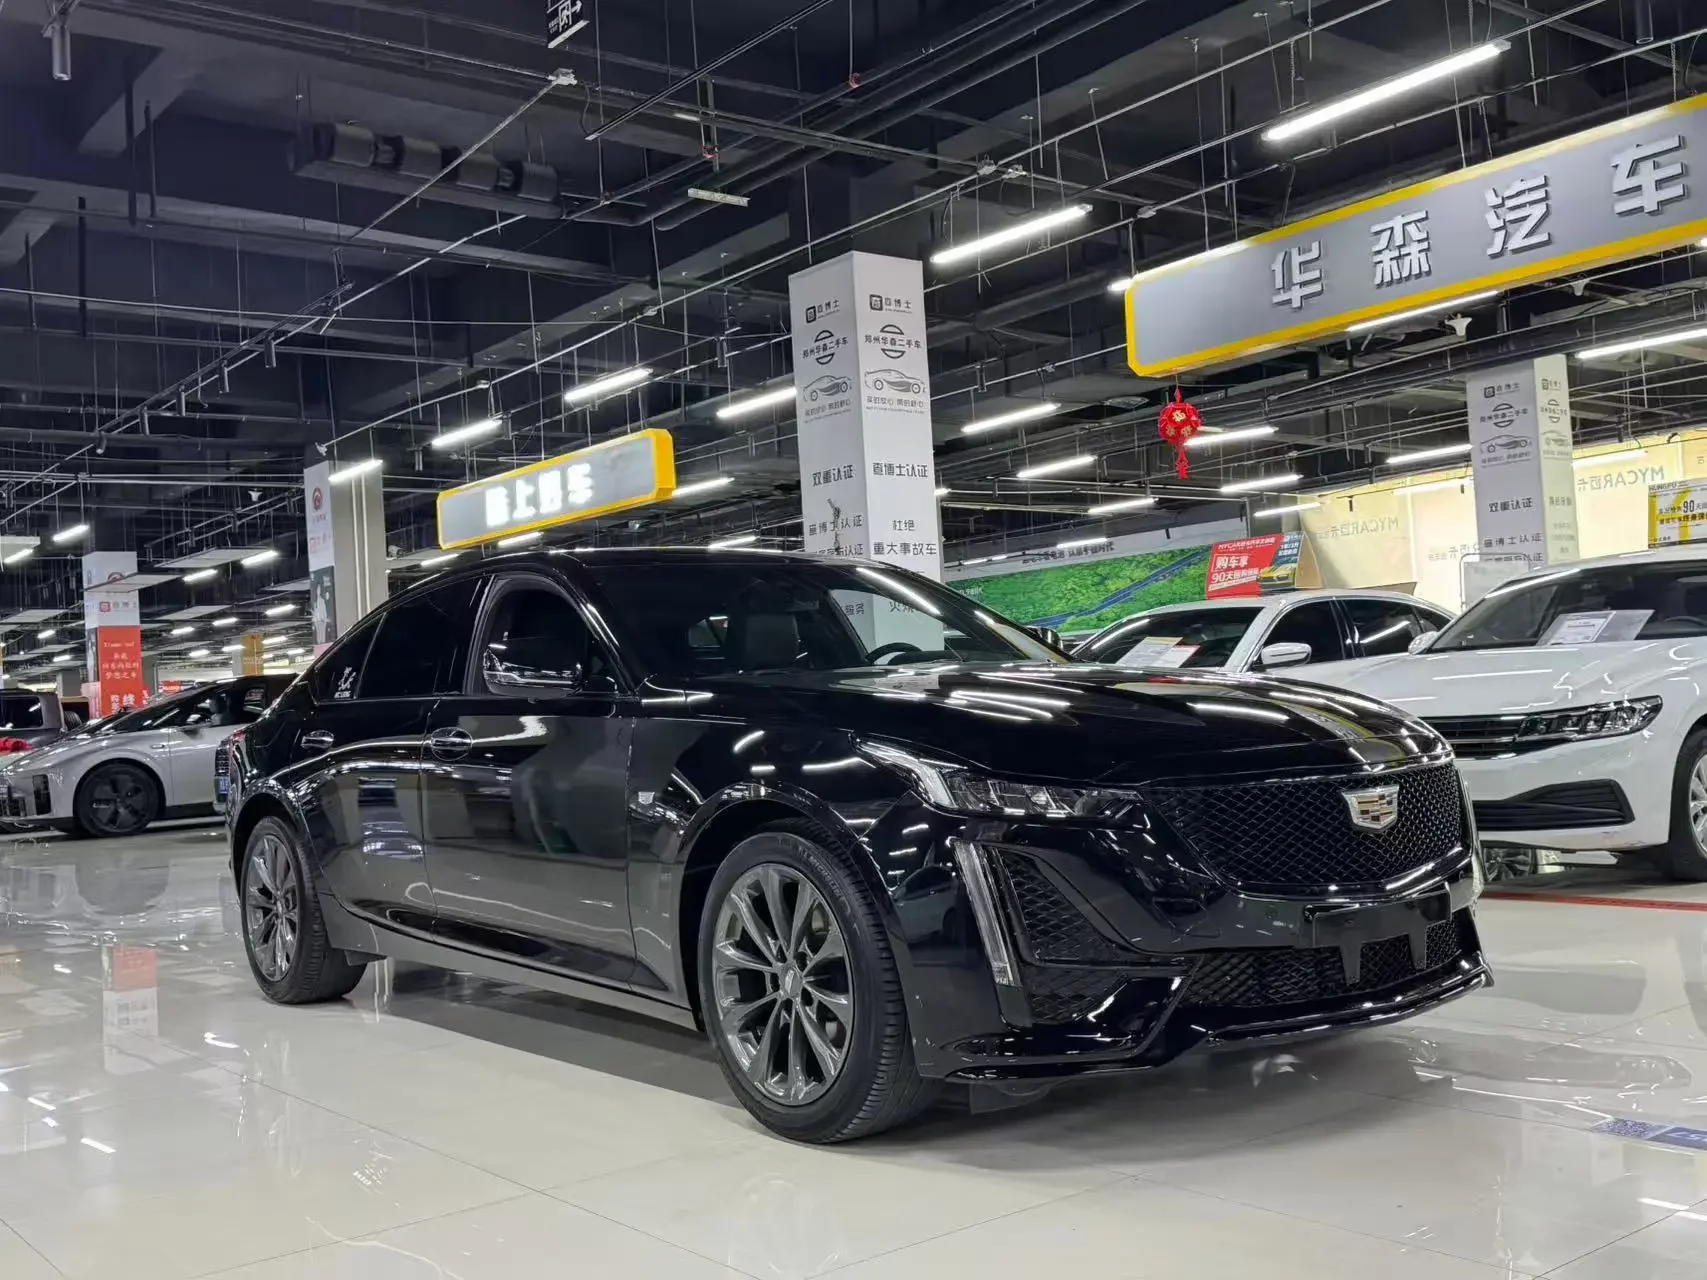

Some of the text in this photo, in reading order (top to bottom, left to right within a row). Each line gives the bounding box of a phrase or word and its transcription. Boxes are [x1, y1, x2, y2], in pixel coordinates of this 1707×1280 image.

[1271, 134, 1688, 309] 华森汽车
[802, 337, 849, 359] 郑州华森二手车
[864, 334, 922, 349] 郑州华森二手车
[812, 464, 854, 488] 双重认证
[1488, 497, 1533, 513] 双重认证
[892, 519, 915, 532] 杜绝
[873, 542, 937, 556] 重大事故车
[1215, 555, 1249, 569] 购车享
